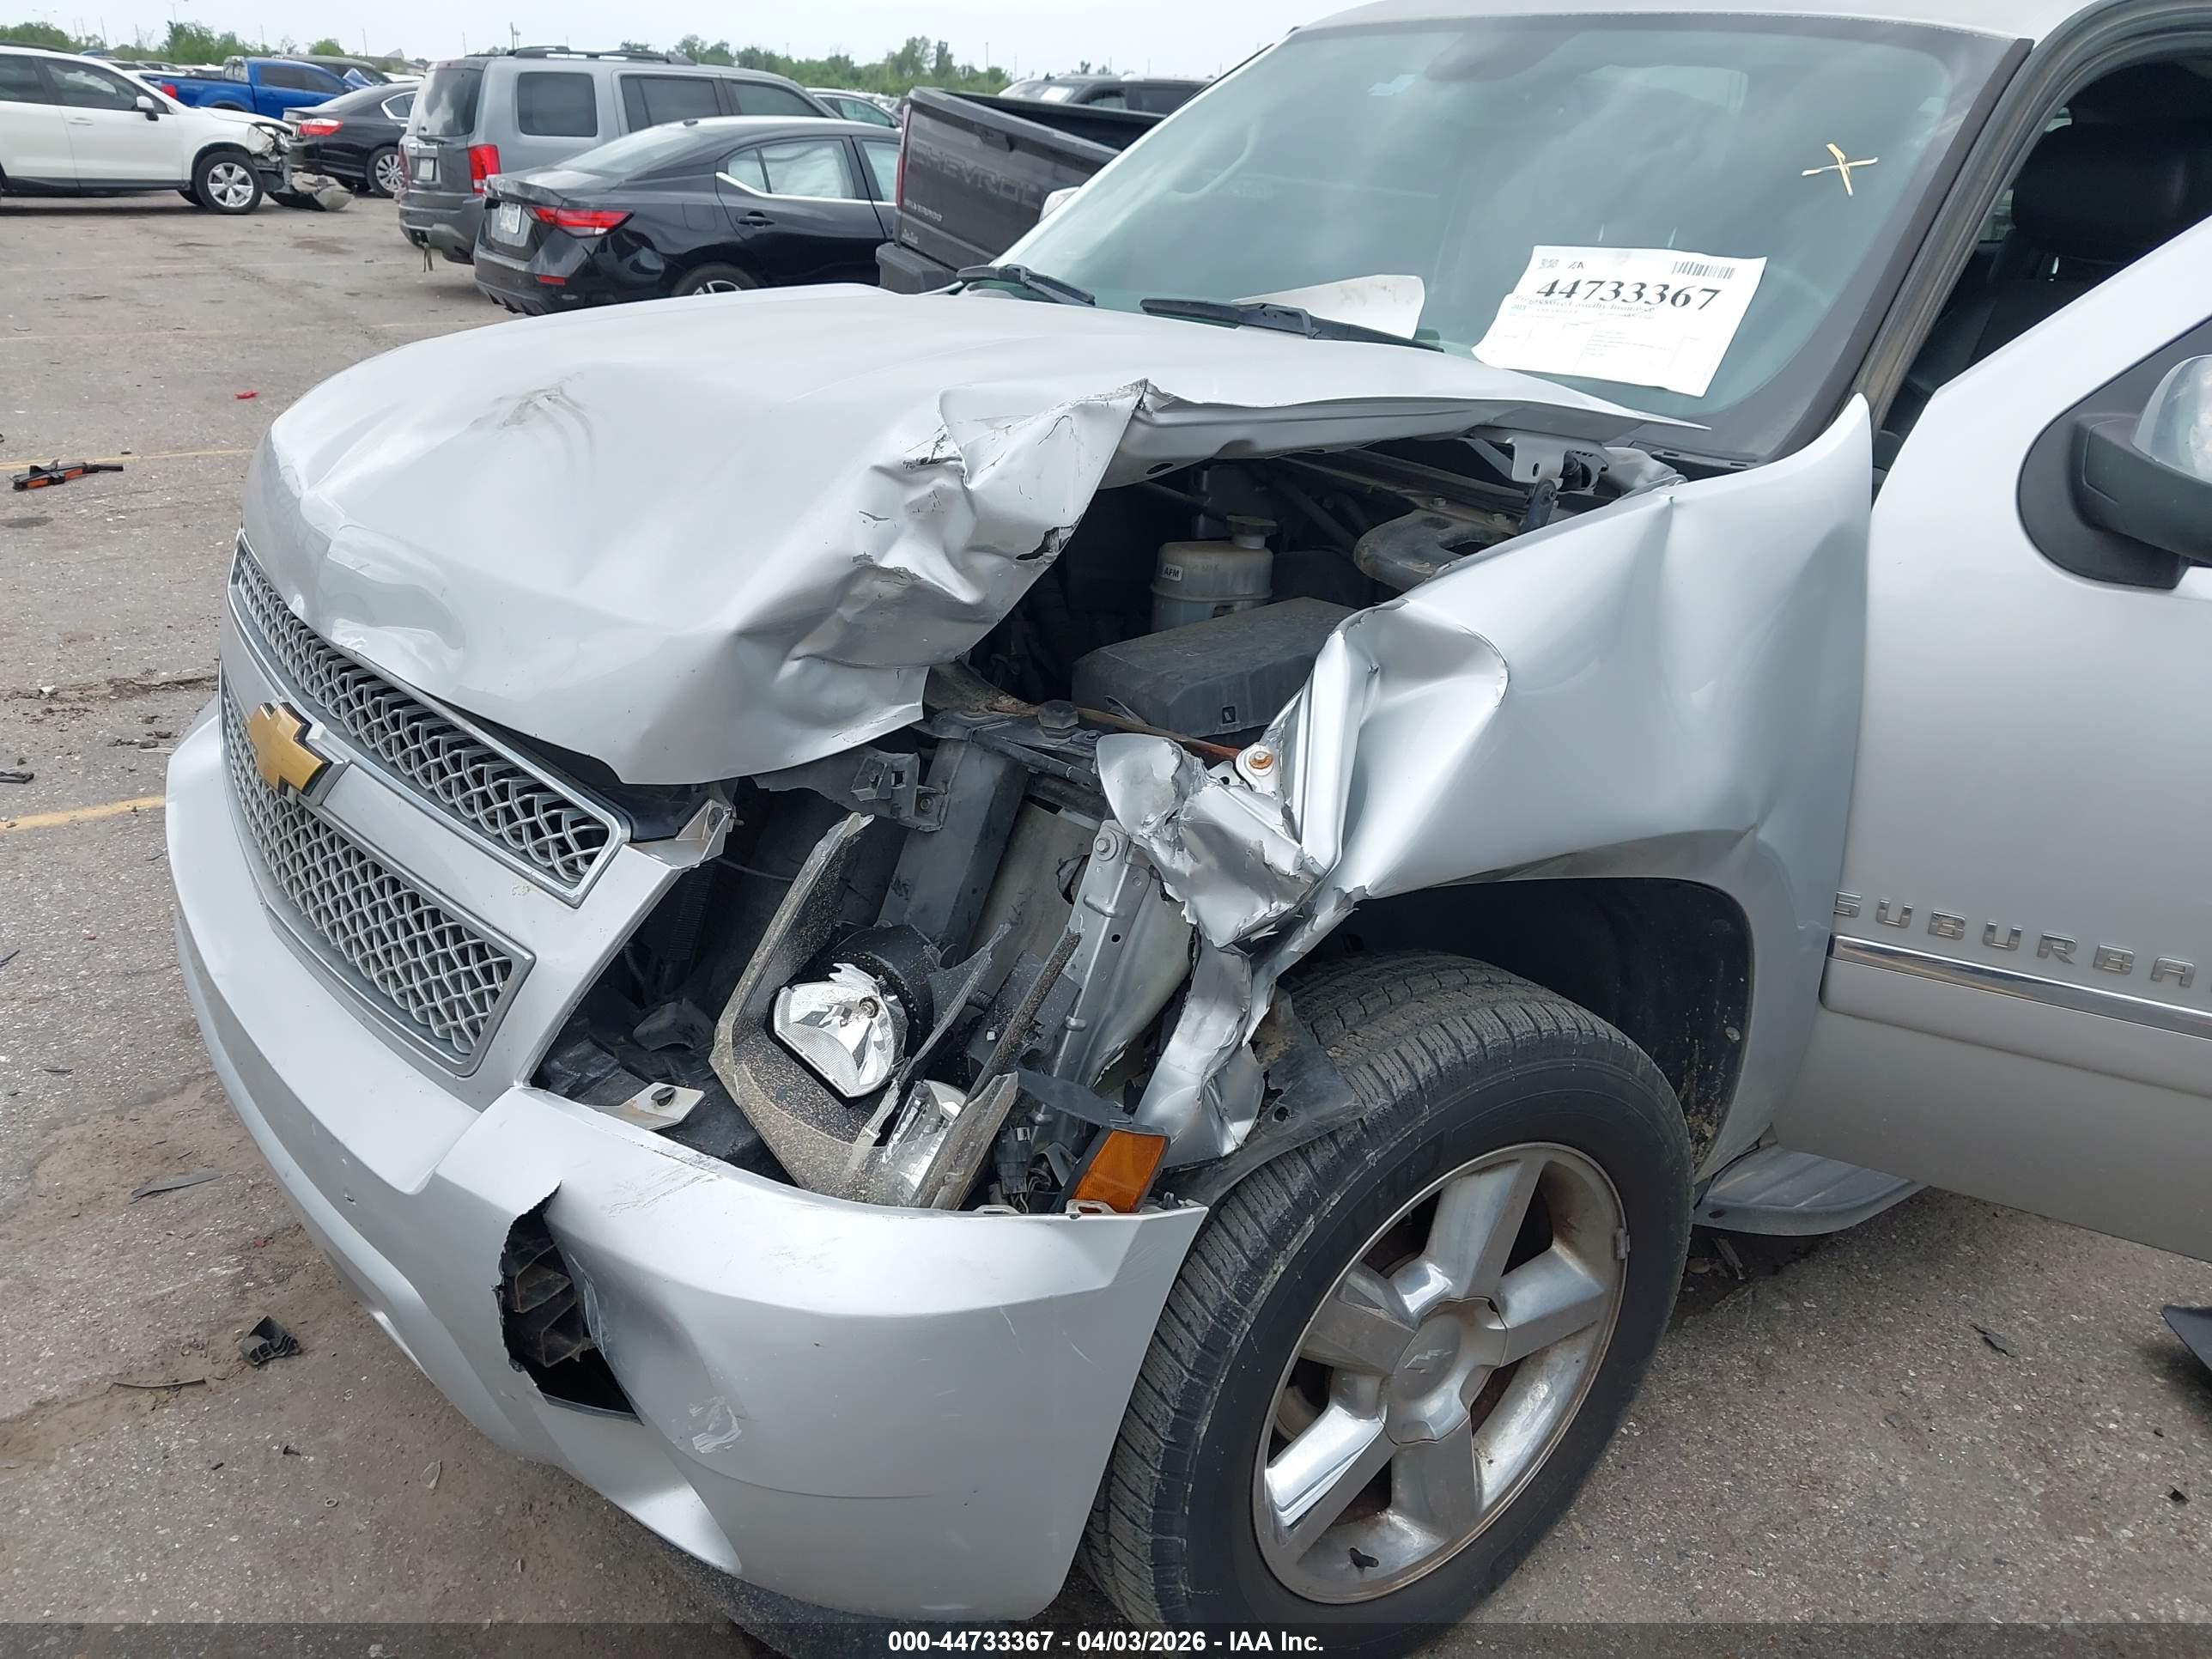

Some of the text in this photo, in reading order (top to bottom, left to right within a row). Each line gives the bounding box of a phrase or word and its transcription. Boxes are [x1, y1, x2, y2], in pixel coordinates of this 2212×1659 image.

[909, 143, 1042, 210] CHEVROL
[1536, 278, 1723, 311] 44733367
[1835, 890, 2212, 988] SUBURBA
